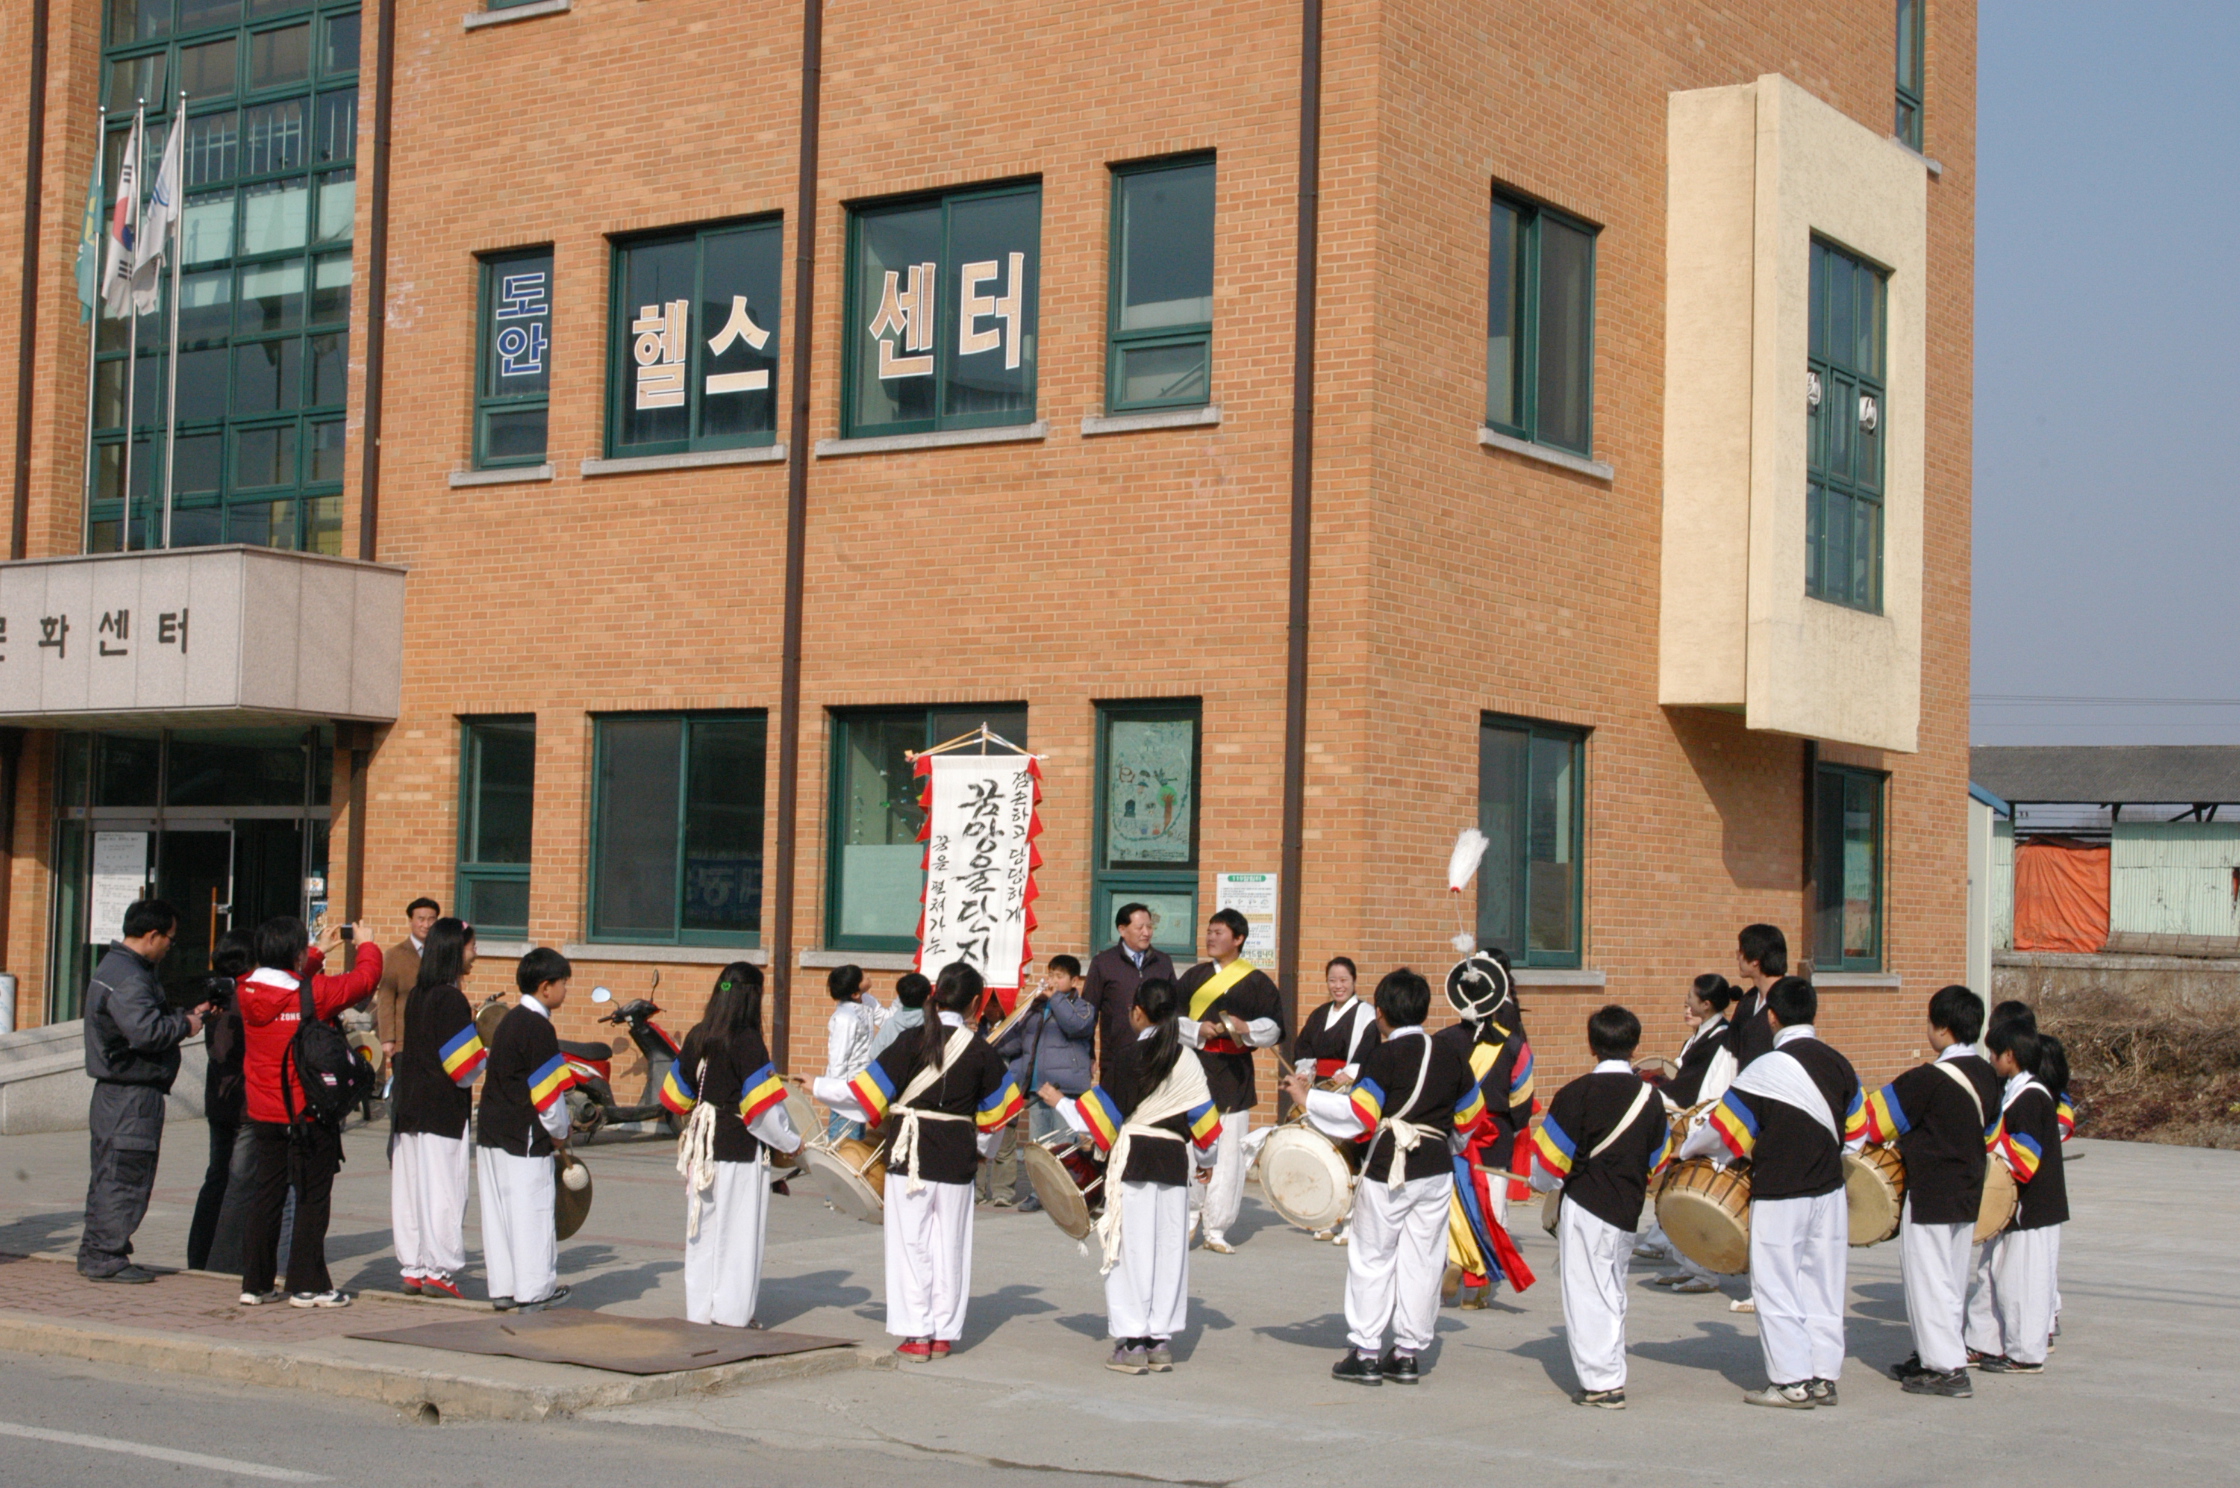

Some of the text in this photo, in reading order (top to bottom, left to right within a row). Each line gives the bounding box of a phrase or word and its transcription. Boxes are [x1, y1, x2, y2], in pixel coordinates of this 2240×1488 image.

[496, 272, 549, 377] 도안
[632, 251, 1025, 411] 헬스 센터
[0, 608, 190, 661] 화센터
